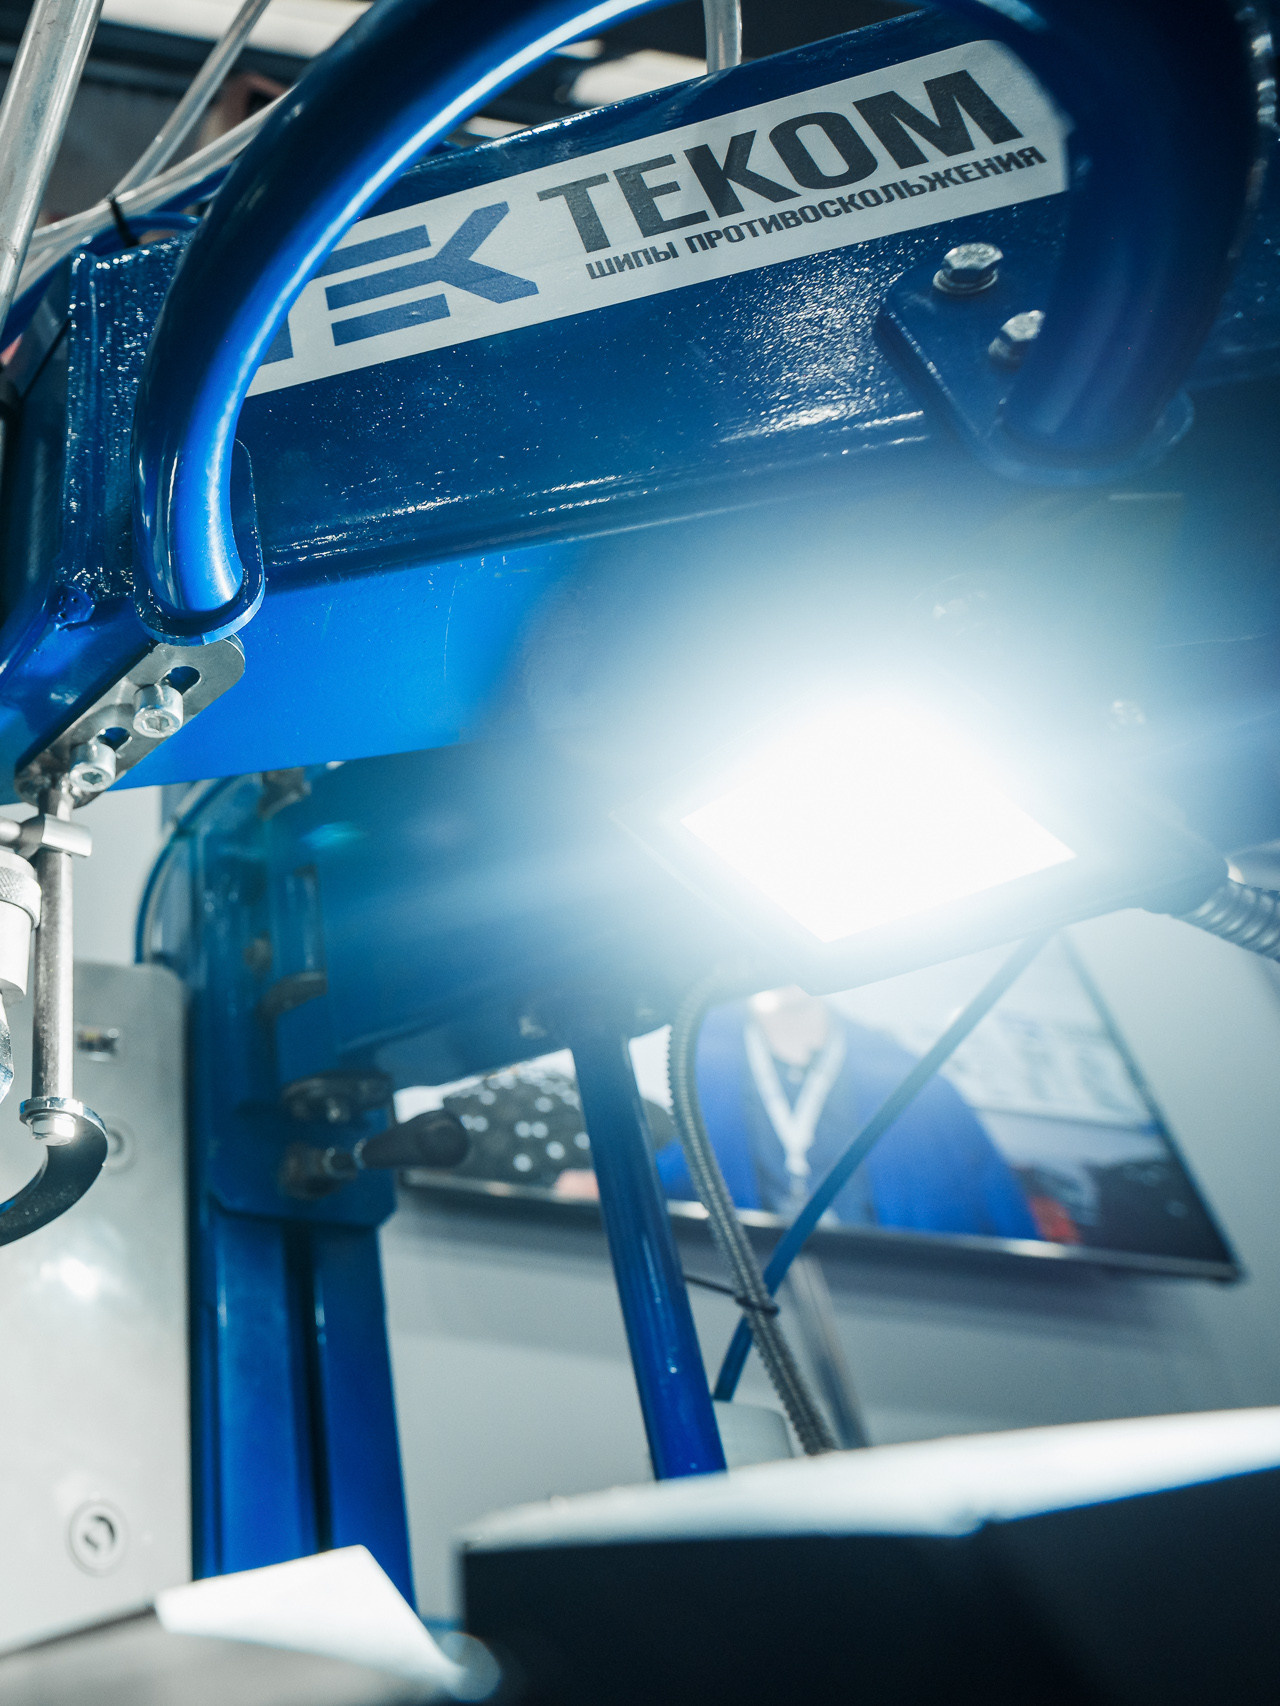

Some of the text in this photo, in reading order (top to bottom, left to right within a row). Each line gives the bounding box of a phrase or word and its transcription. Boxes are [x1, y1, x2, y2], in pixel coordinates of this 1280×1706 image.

[537, 69, 1024, 254] ТЕКОМ
[586, 146, 1047, 280] ШИПЫ ПРОТИВОСКОЛЬЖЕНИЯ
